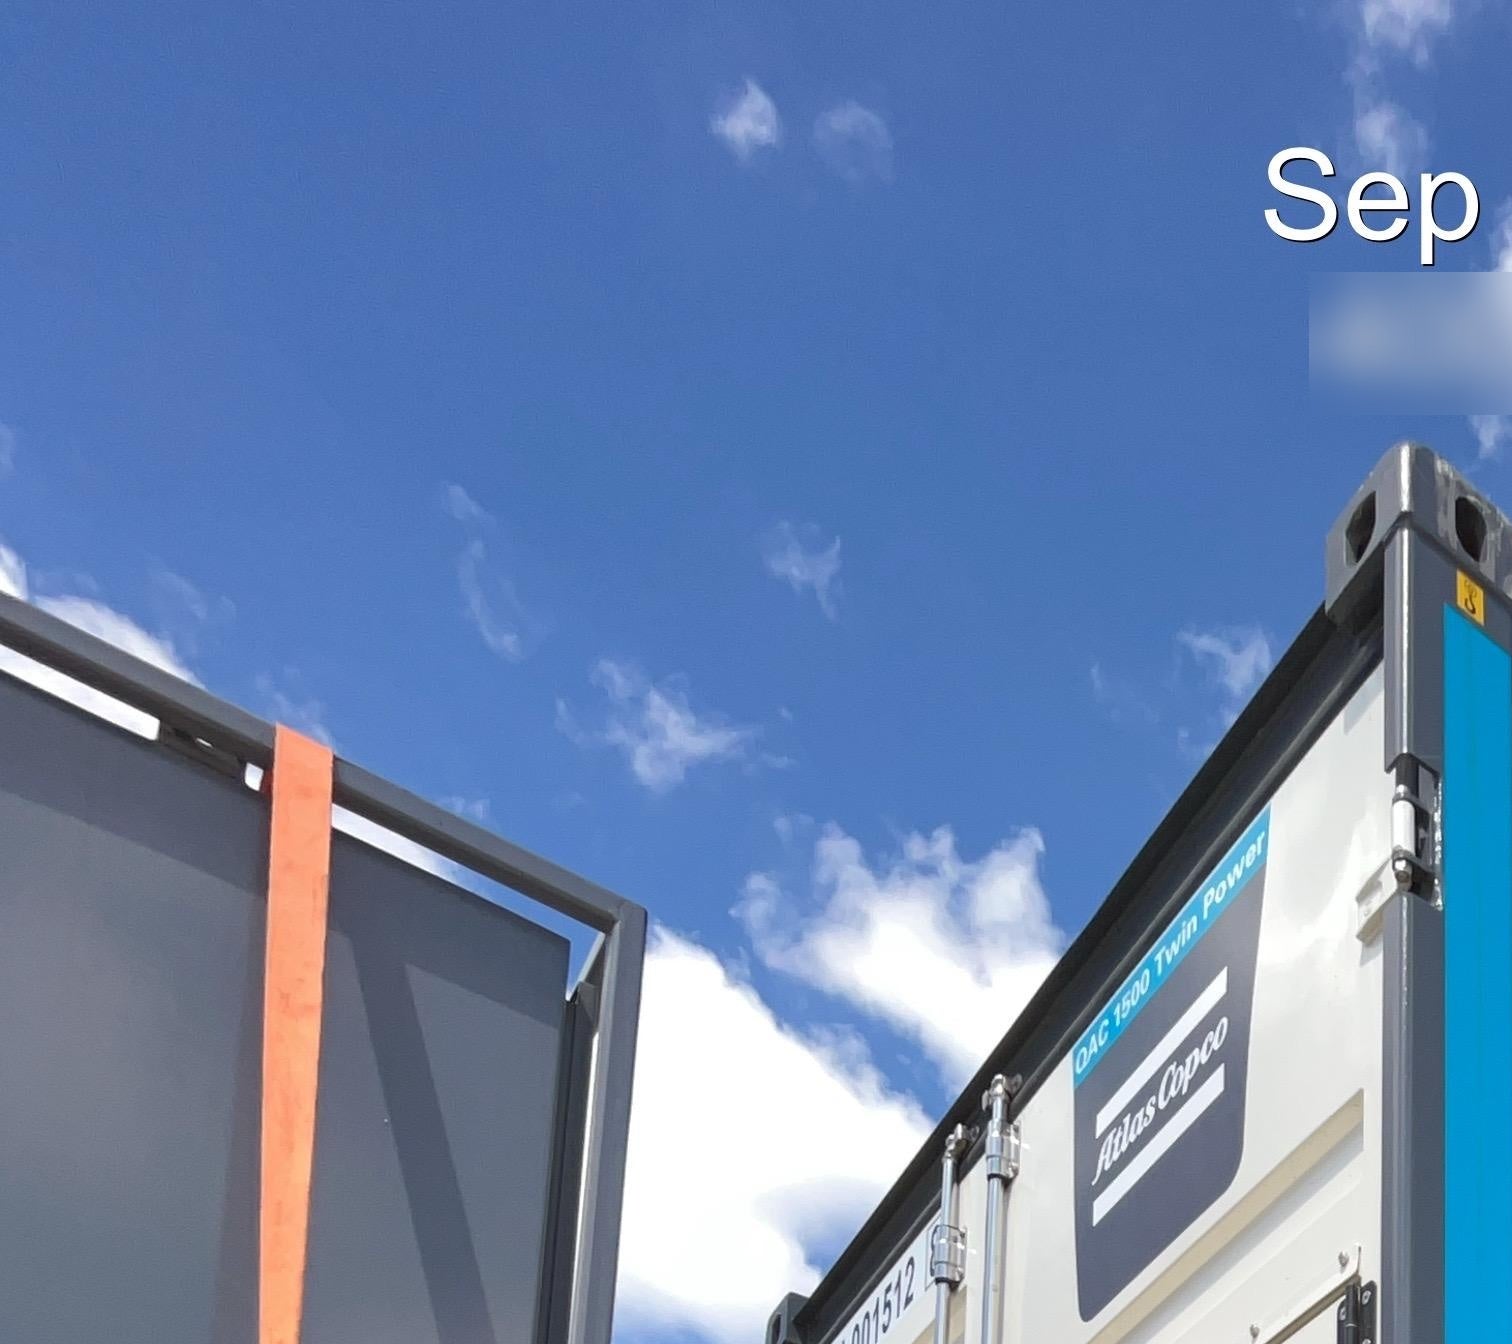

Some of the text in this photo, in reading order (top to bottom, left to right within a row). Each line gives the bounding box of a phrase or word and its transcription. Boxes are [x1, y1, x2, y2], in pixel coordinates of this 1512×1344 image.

[1075, 831, 1266, 1075] QAC 1500 Twin Power
[1091, 1015, 1230, 1187] Atlas Copco
